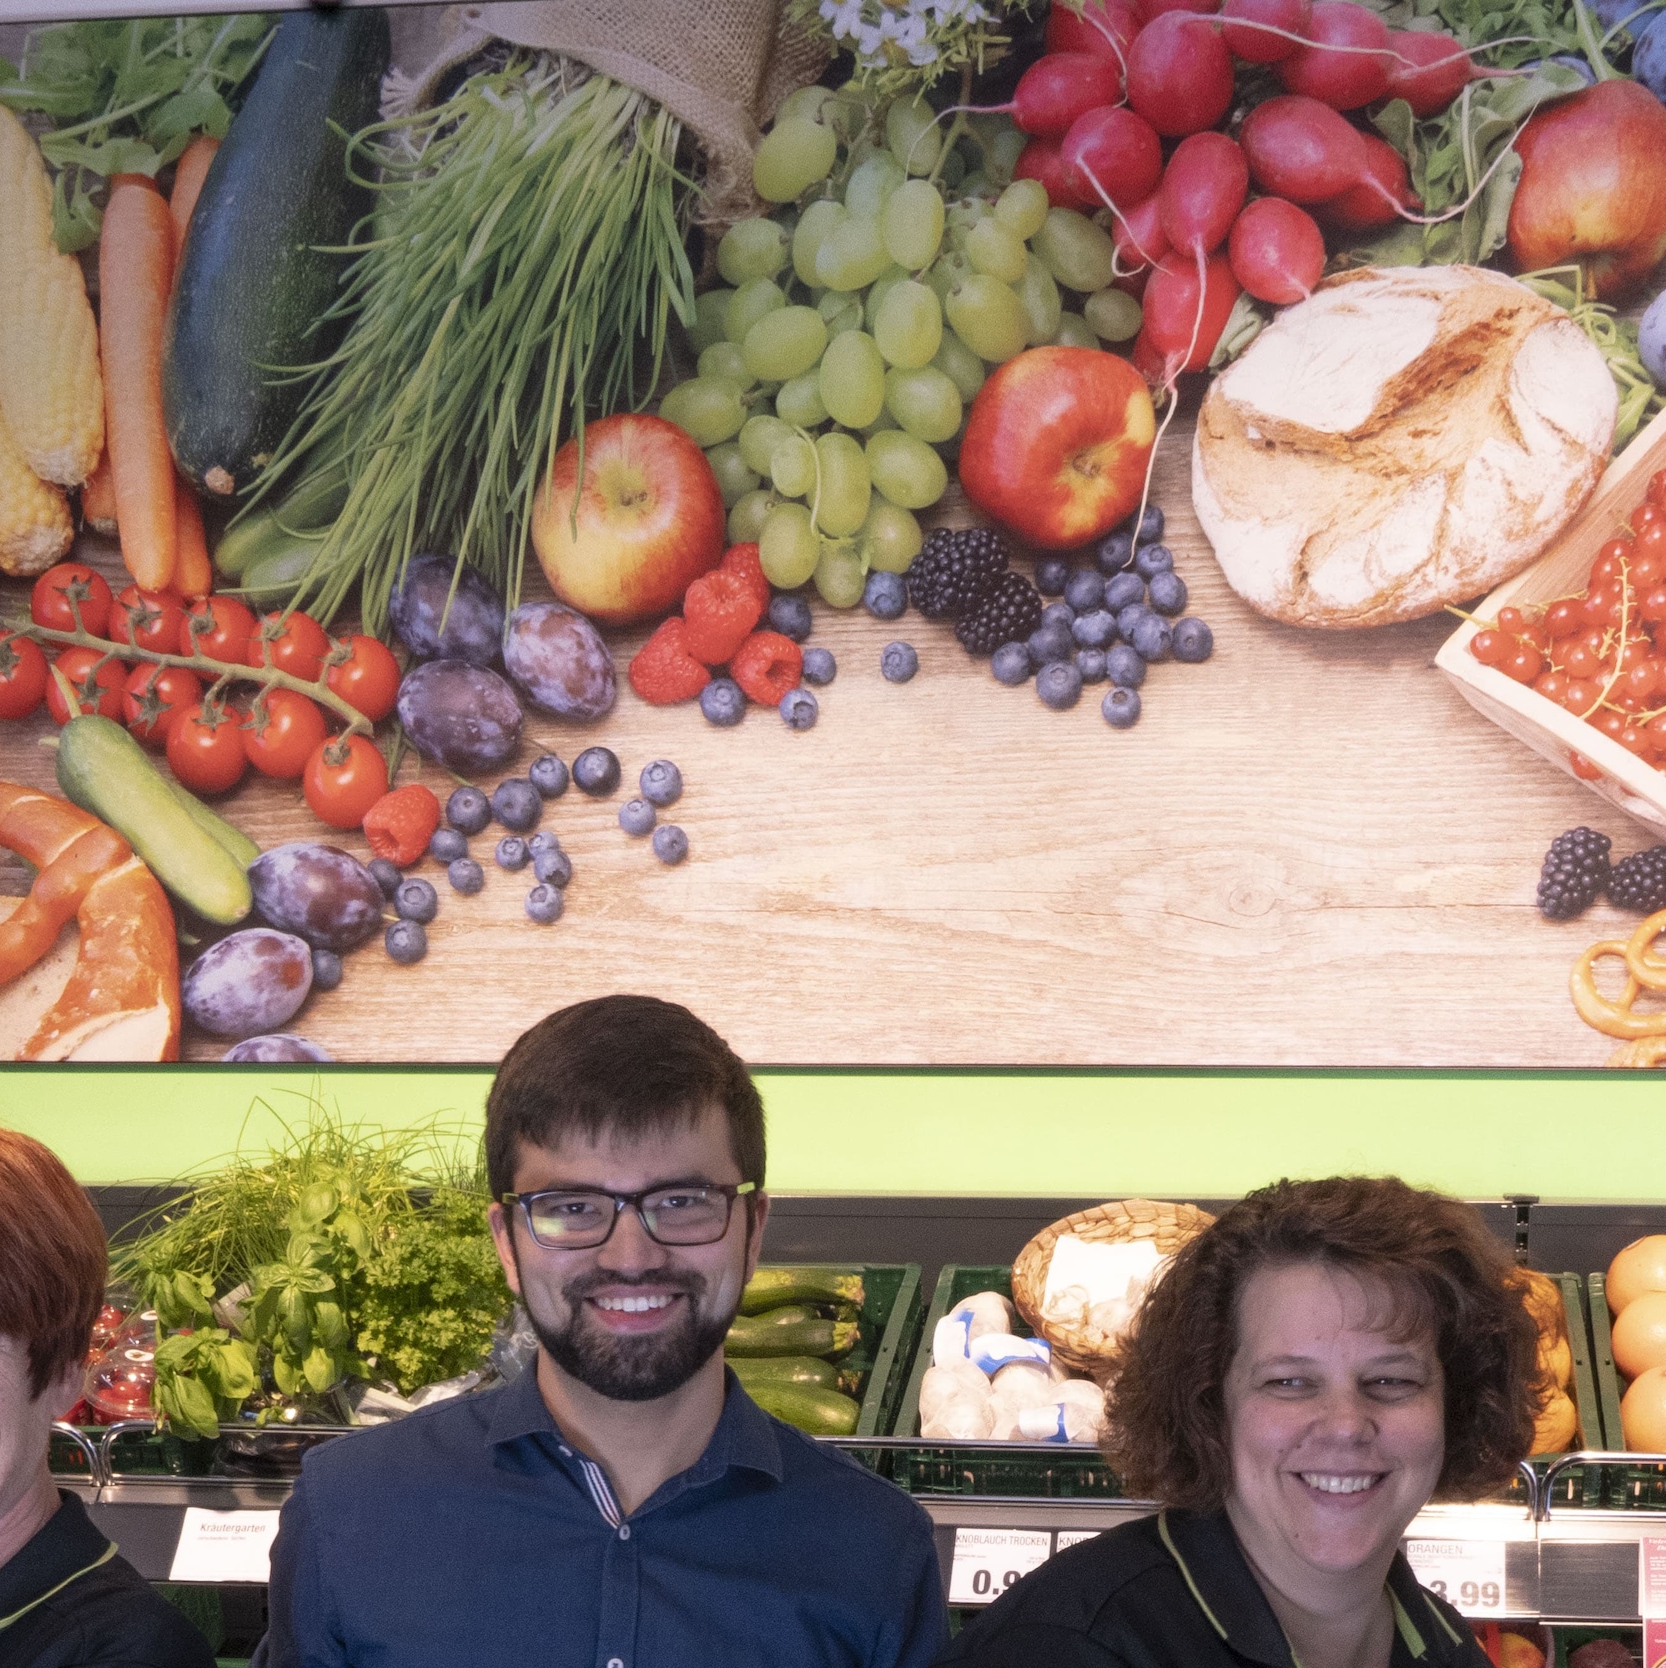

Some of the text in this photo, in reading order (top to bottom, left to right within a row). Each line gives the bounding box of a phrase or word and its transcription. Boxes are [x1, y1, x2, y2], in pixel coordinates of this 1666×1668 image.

[199, 1523, 266, 1534] Kräutergarten
[955, 1534, 1047, 1546] KNOBLAUCH TROCKEN
[1408, 1544, 1463, 1554] ORANGEN
[972, 1569, 1029, 1595] 0.9
[1430, 1581, 1500, 1608] 3.99
